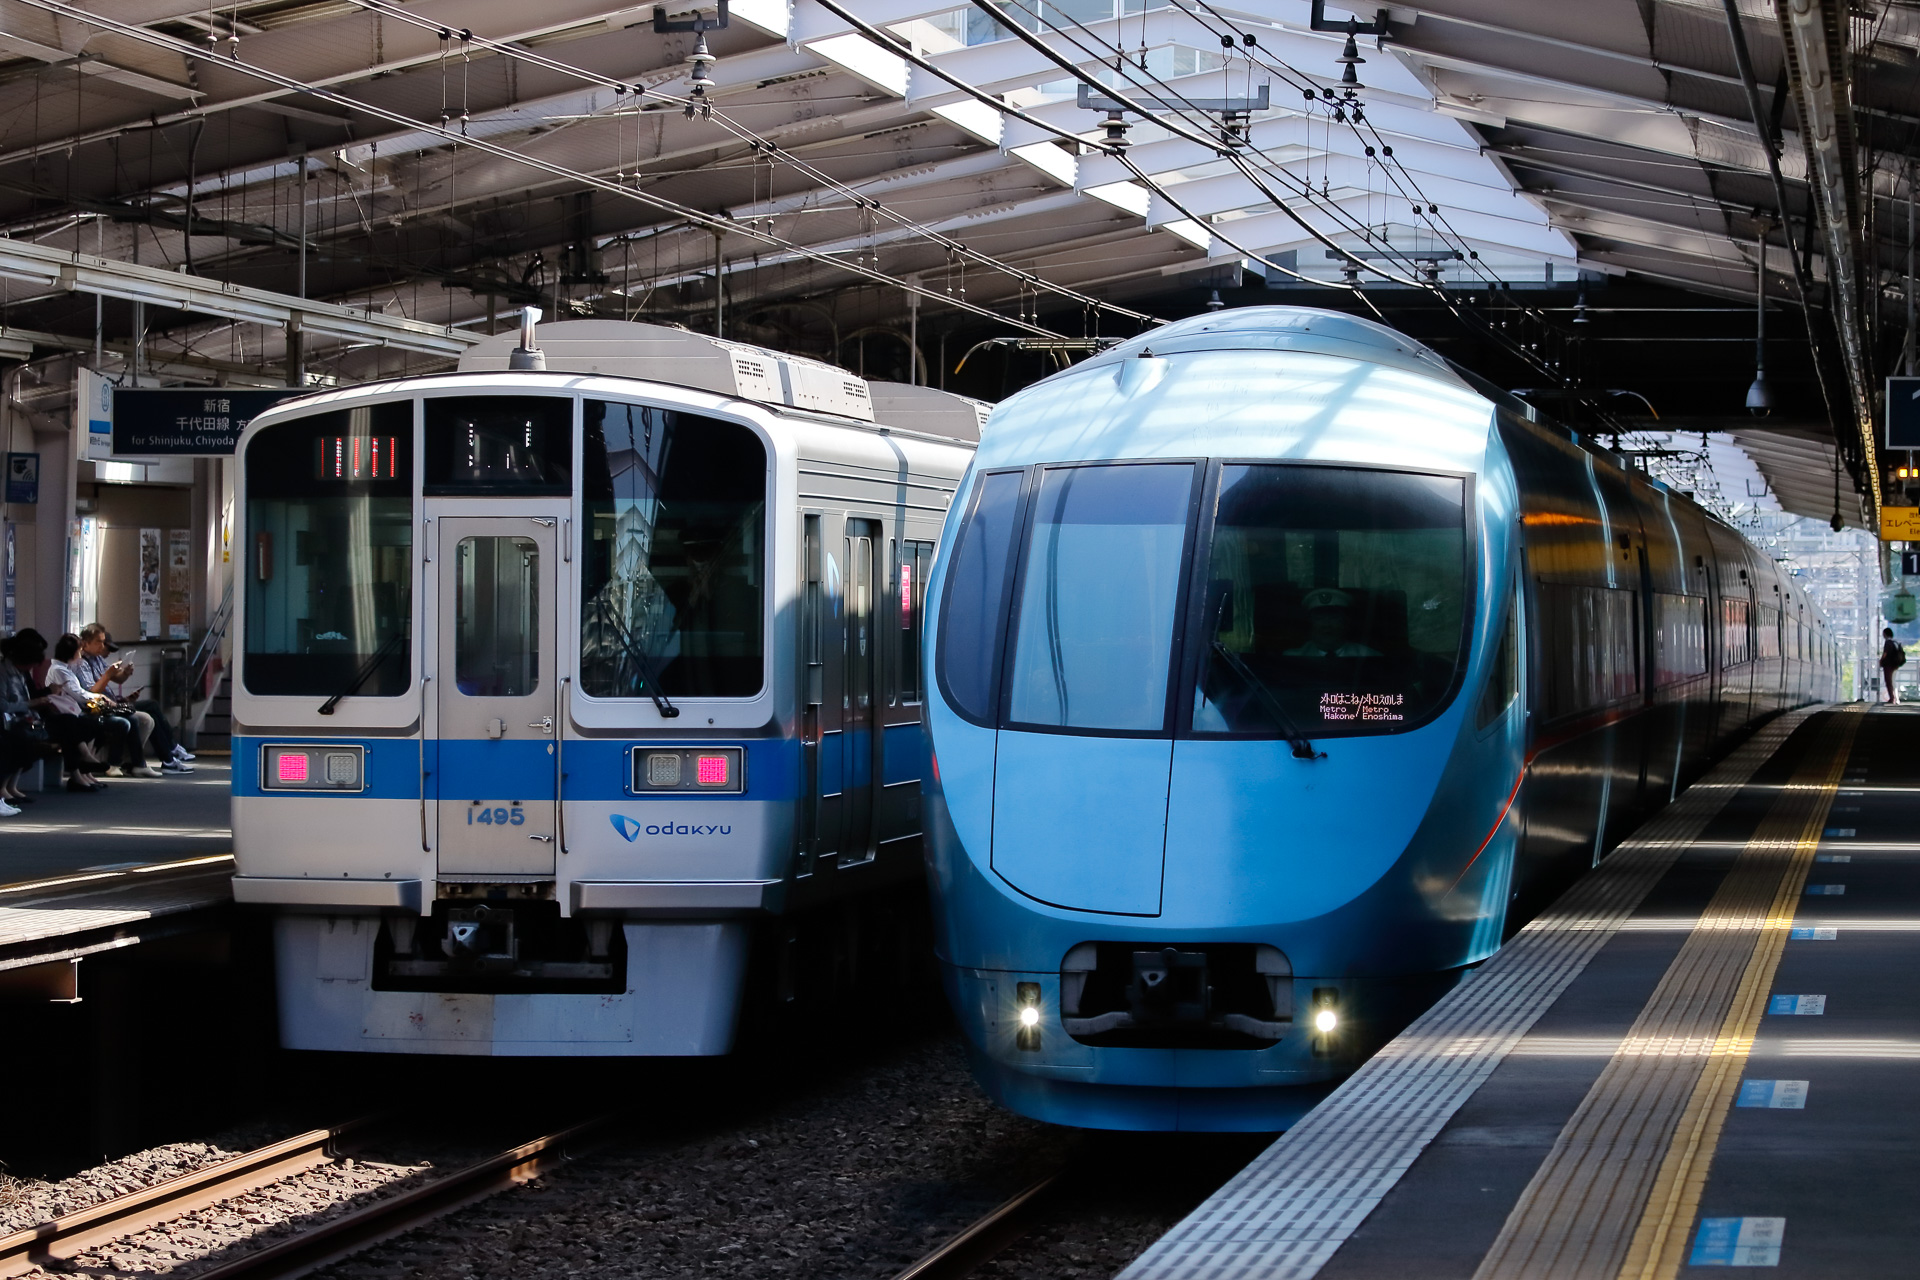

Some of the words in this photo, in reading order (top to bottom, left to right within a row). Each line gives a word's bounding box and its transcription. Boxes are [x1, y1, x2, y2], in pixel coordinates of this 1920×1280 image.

[203, 398, 230, 413] 新宿
[176, 416, 230, 431] 千代田線
[132, 435, 145, 446] for
[148, 435, 194, 448] Shinjuku,
[195, 435, 235, 448] Chiyoda
[1910, 554, 1918, 574] 1
[1319, 705, 1347, 713] Metro
[1362, 705, 1390, 713] Metro
[1324, 712, 1356, 720] Hakone
[1362, 712, 1404, 721] Enoshima
[467, 807, 525, 826] 1495
[645, 821, 732, 836] odakyu
